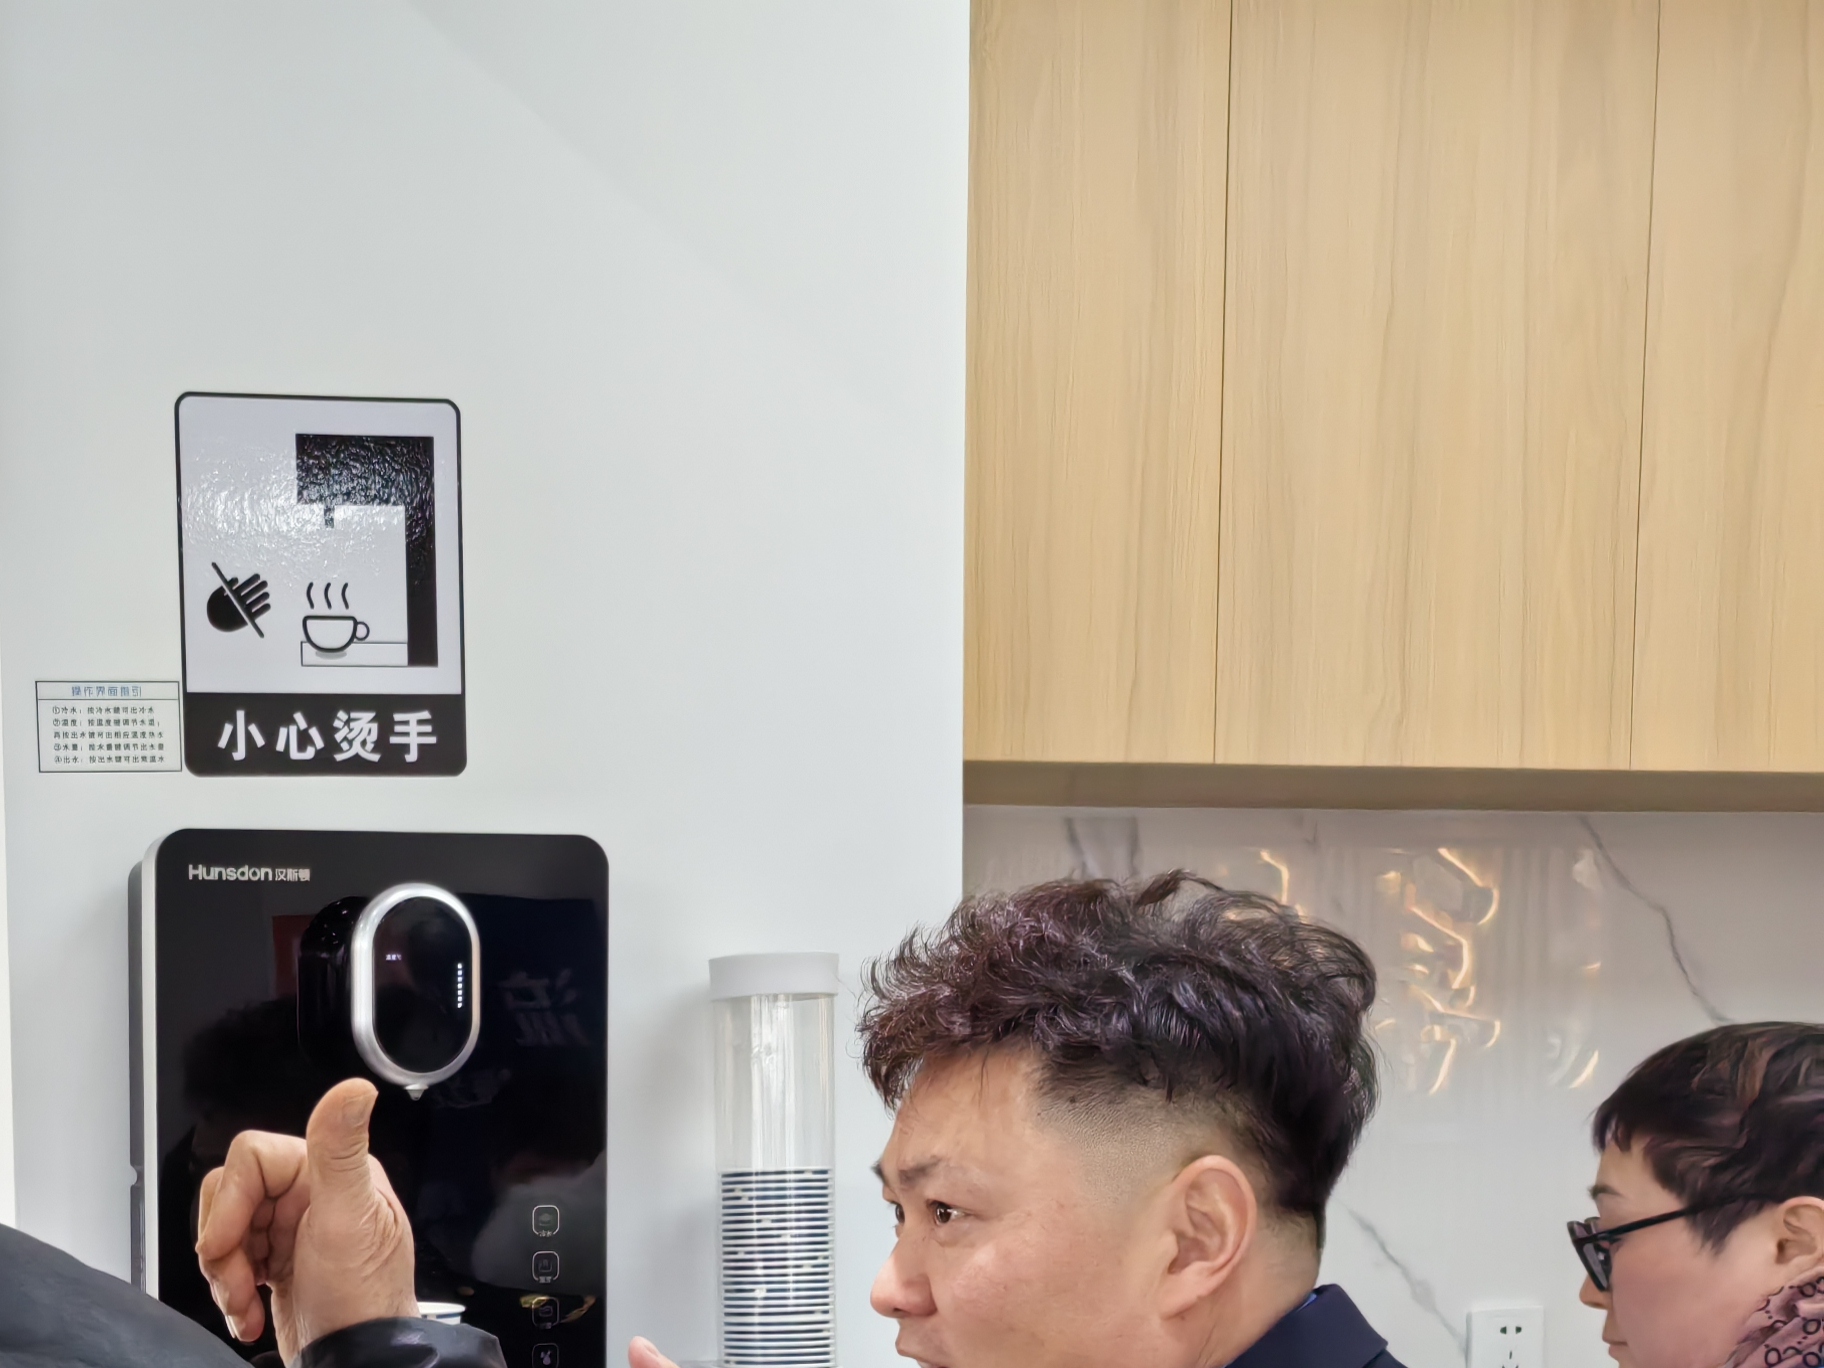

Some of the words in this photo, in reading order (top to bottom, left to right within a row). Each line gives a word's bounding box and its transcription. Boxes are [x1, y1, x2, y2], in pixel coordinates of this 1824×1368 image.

[217, 709, 438, 763] 小心烫手
[188, 864, 273, 881] Hunsdon
